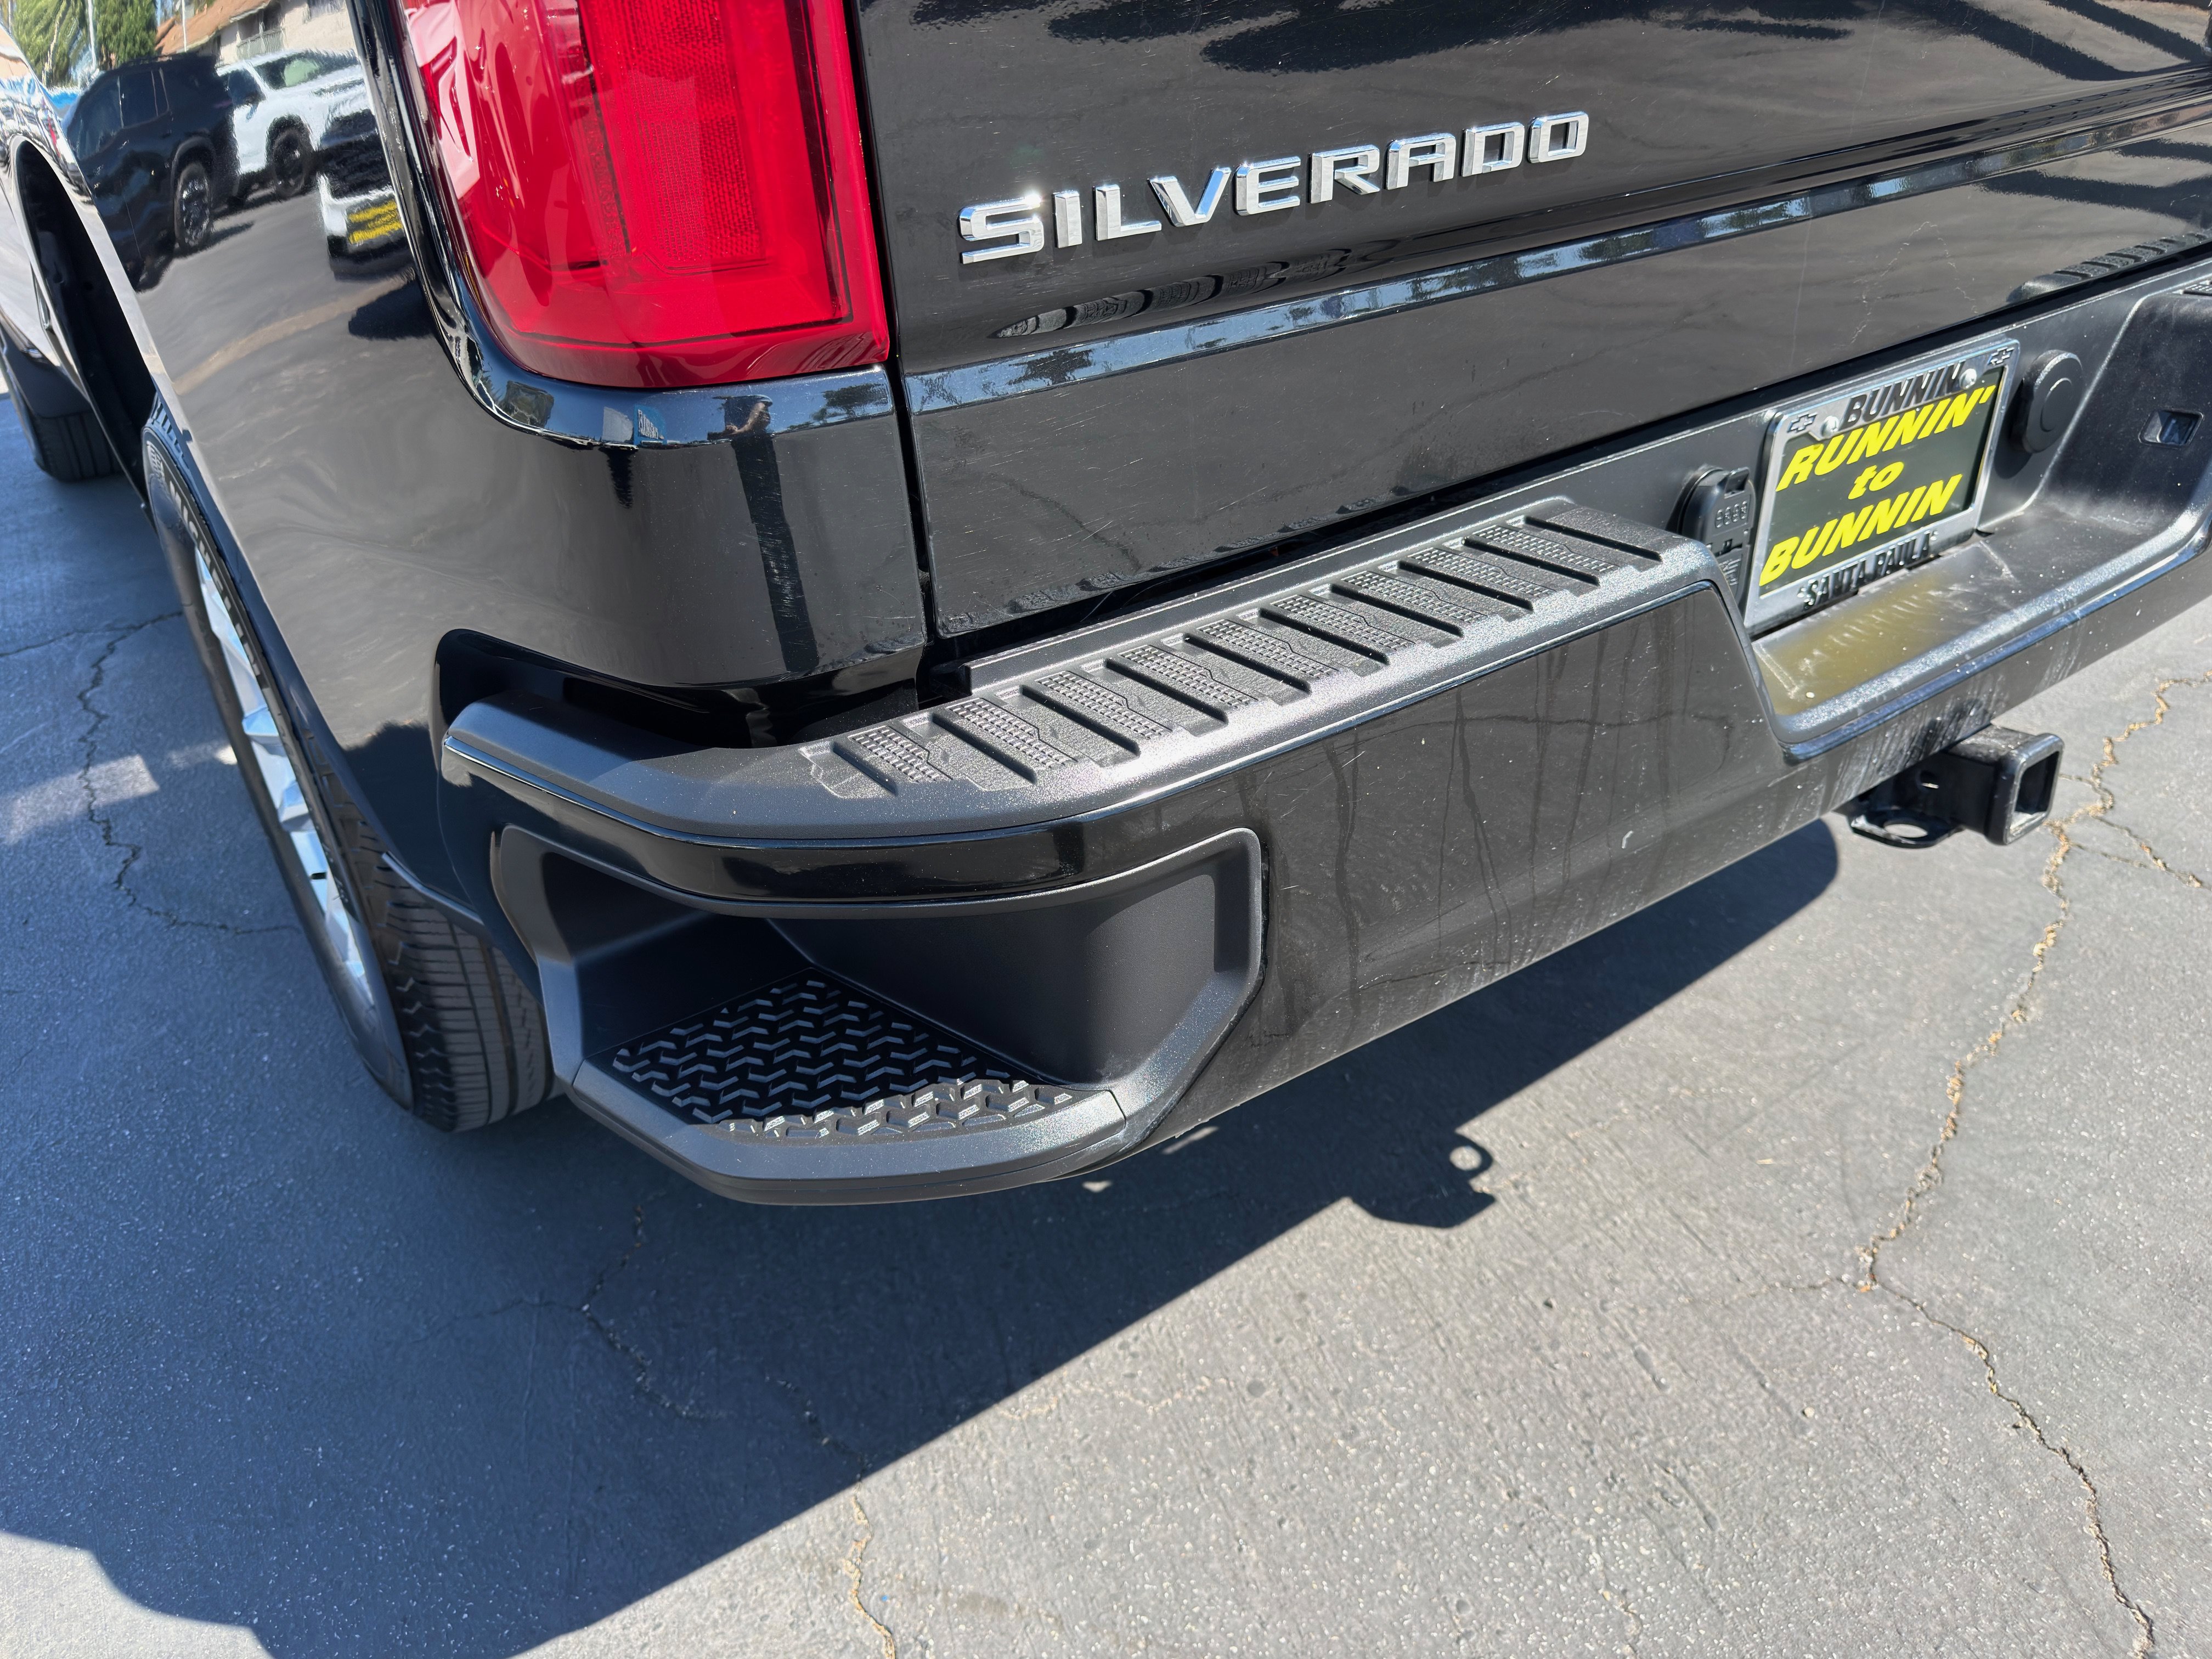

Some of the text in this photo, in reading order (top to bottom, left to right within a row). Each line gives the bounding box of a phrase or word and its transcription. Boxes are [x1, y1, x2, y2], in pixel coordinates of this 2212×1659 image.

[959, 111, 1589, 265] SILVERADO
[1776, 385, 1996, 492] RUNNIN'
[1838, 359, 1966, 431] BUNNIN
[1759, 473, 1963, 586] BUNNIN
[1848, 461, 1905, 500] to
